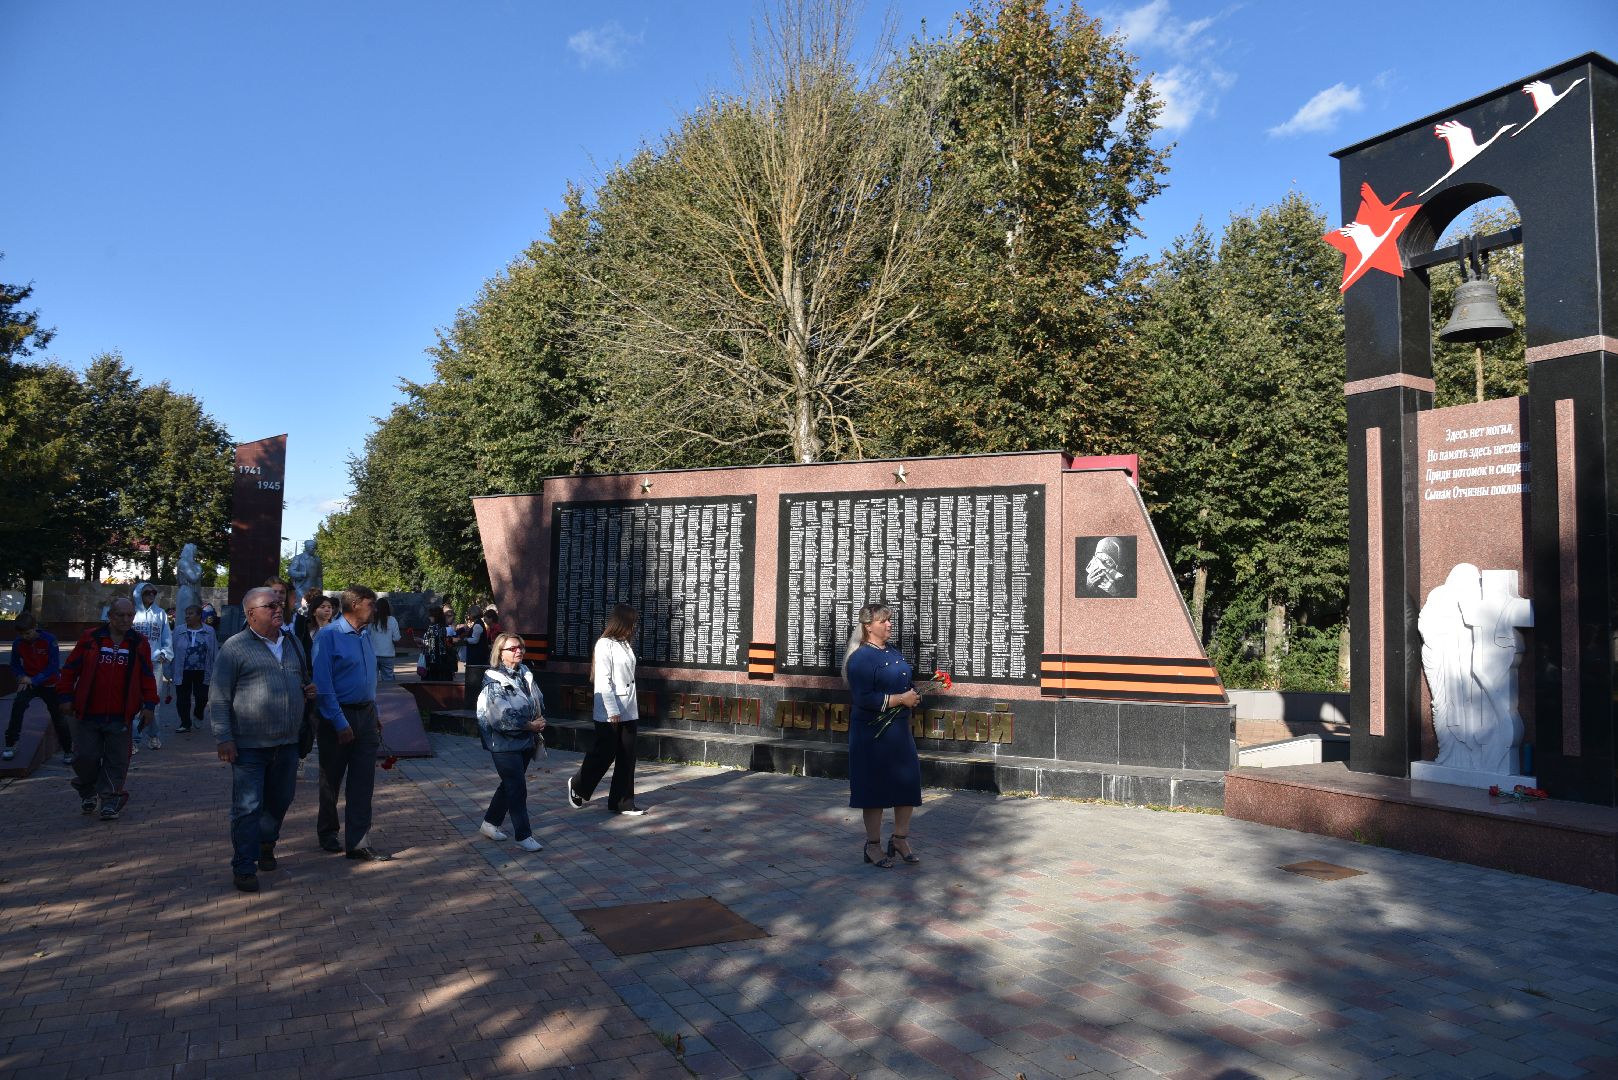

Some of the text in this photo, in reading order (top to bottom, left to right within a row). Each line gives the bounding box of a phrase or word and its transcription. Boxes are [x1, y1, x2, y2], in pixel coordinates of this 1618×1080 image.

[1445, 423, 1514, 443] Здесь нет могил,
[1427, 449, 1438, 462] Но
[1439, 449, 1468, 461] память
[1469, 447, 1492, 459] здесь
[239, 465, 261, 475] 1941
[1426, 468, 1451, 484] Приди
[1452, 466, 1488, 479] потомок
[1488, 465, 1495, 476] и
[257, 480, 281, 490] 1945
[1424, 488, 1452, 501] Сынам
[1453, 485, 1490, 498] Отчизны
[669, 692, 761, 727] ЗЕМЛИ
[772, 699, 1015, 744] ЛОТОНСКОЙ
